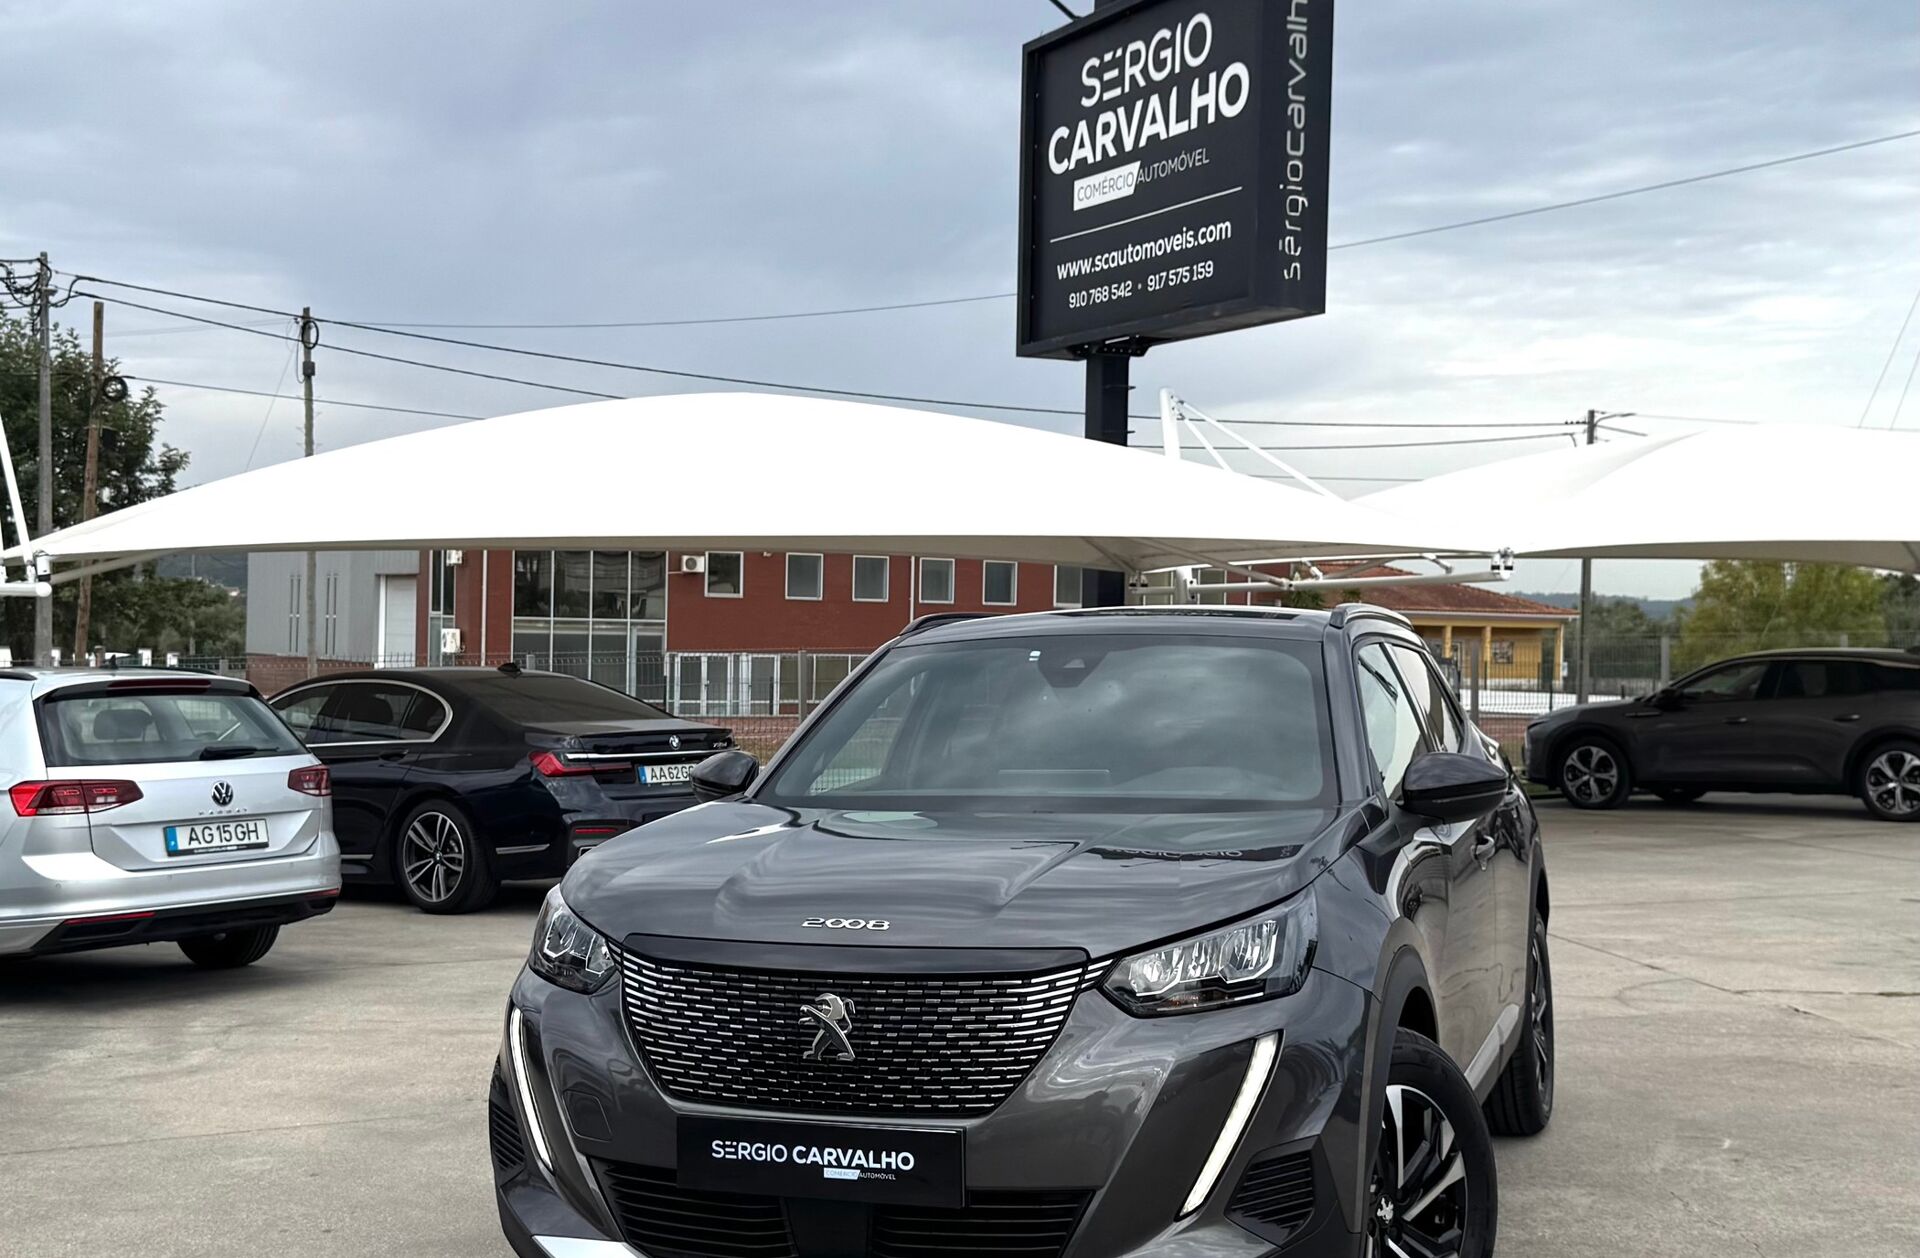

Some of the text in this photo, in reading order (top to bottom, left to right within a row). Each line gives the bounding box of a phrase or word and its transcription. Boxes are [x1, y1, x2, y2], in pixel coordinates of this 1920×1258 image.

[1049, 61, 1250, 175] CARVALHO
[1076, 148, 1210, 202] COMÉRCIO AUTOMÓVEL
[1057, 220, 1232, 280] www.scautomoveis.com
[1069, 260, 1214, 309] 910 768 542 917 575 159
[801, 917, 890, 930] 2008
[792, 1145, 915, 1171] CARVALHO
